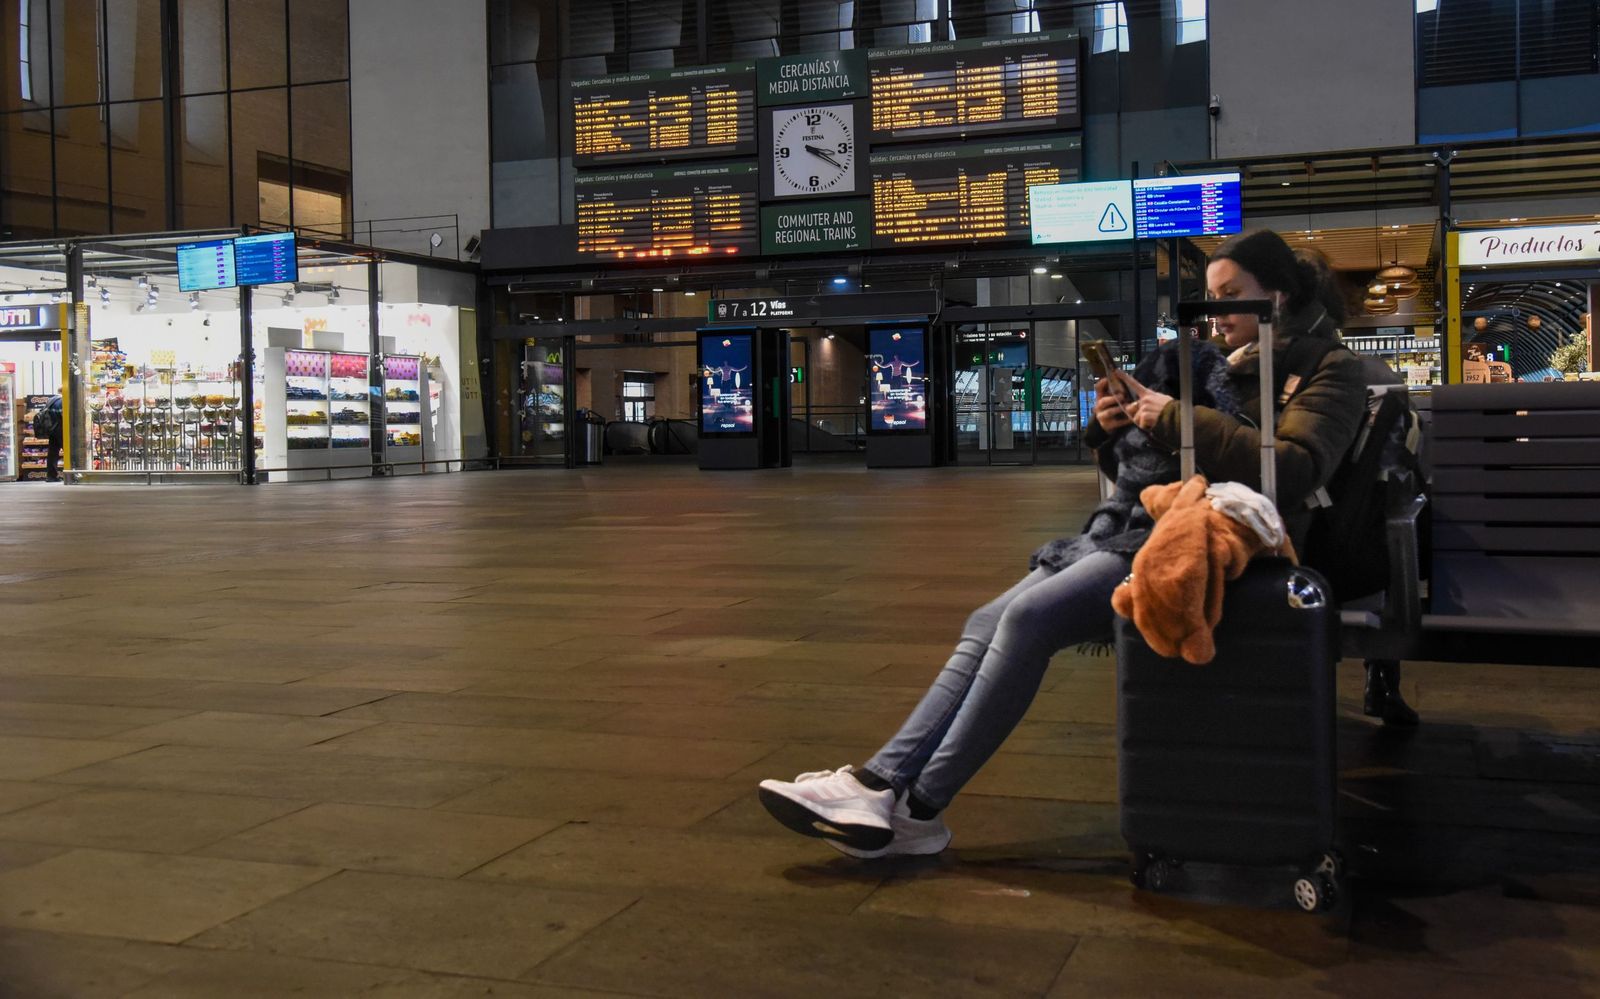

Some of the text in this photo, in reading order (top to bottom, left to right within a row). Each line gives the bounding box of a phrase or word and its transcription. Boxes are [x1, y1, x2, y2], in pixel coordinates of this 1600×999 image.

[780, 59, 840, 78] CERCANÍAS Y
[769, 75, 849, 94] MEDIA DISTANCIA
[805, 114, 821, 126] 12
[780, 143, 848, 158] 9 3
[870, 155, 889, 163] Salidas:
[890, 153, 912, 162] Cercanías
[933, 150, 956, 158] distancia
[595, 174, 615, 182] Cercanías
[809, 176, 819, 187] 6
[778, 211, 853, 228] COMMUTER AND
[776, 226, 856, 244] REGIONAL TRAINS
[1480, 236, 1585, 258] Productos
[732, 304, 739, 317] 7
[750, 302, 766, 316] 12
[770, 300, 786, 309] Vías
